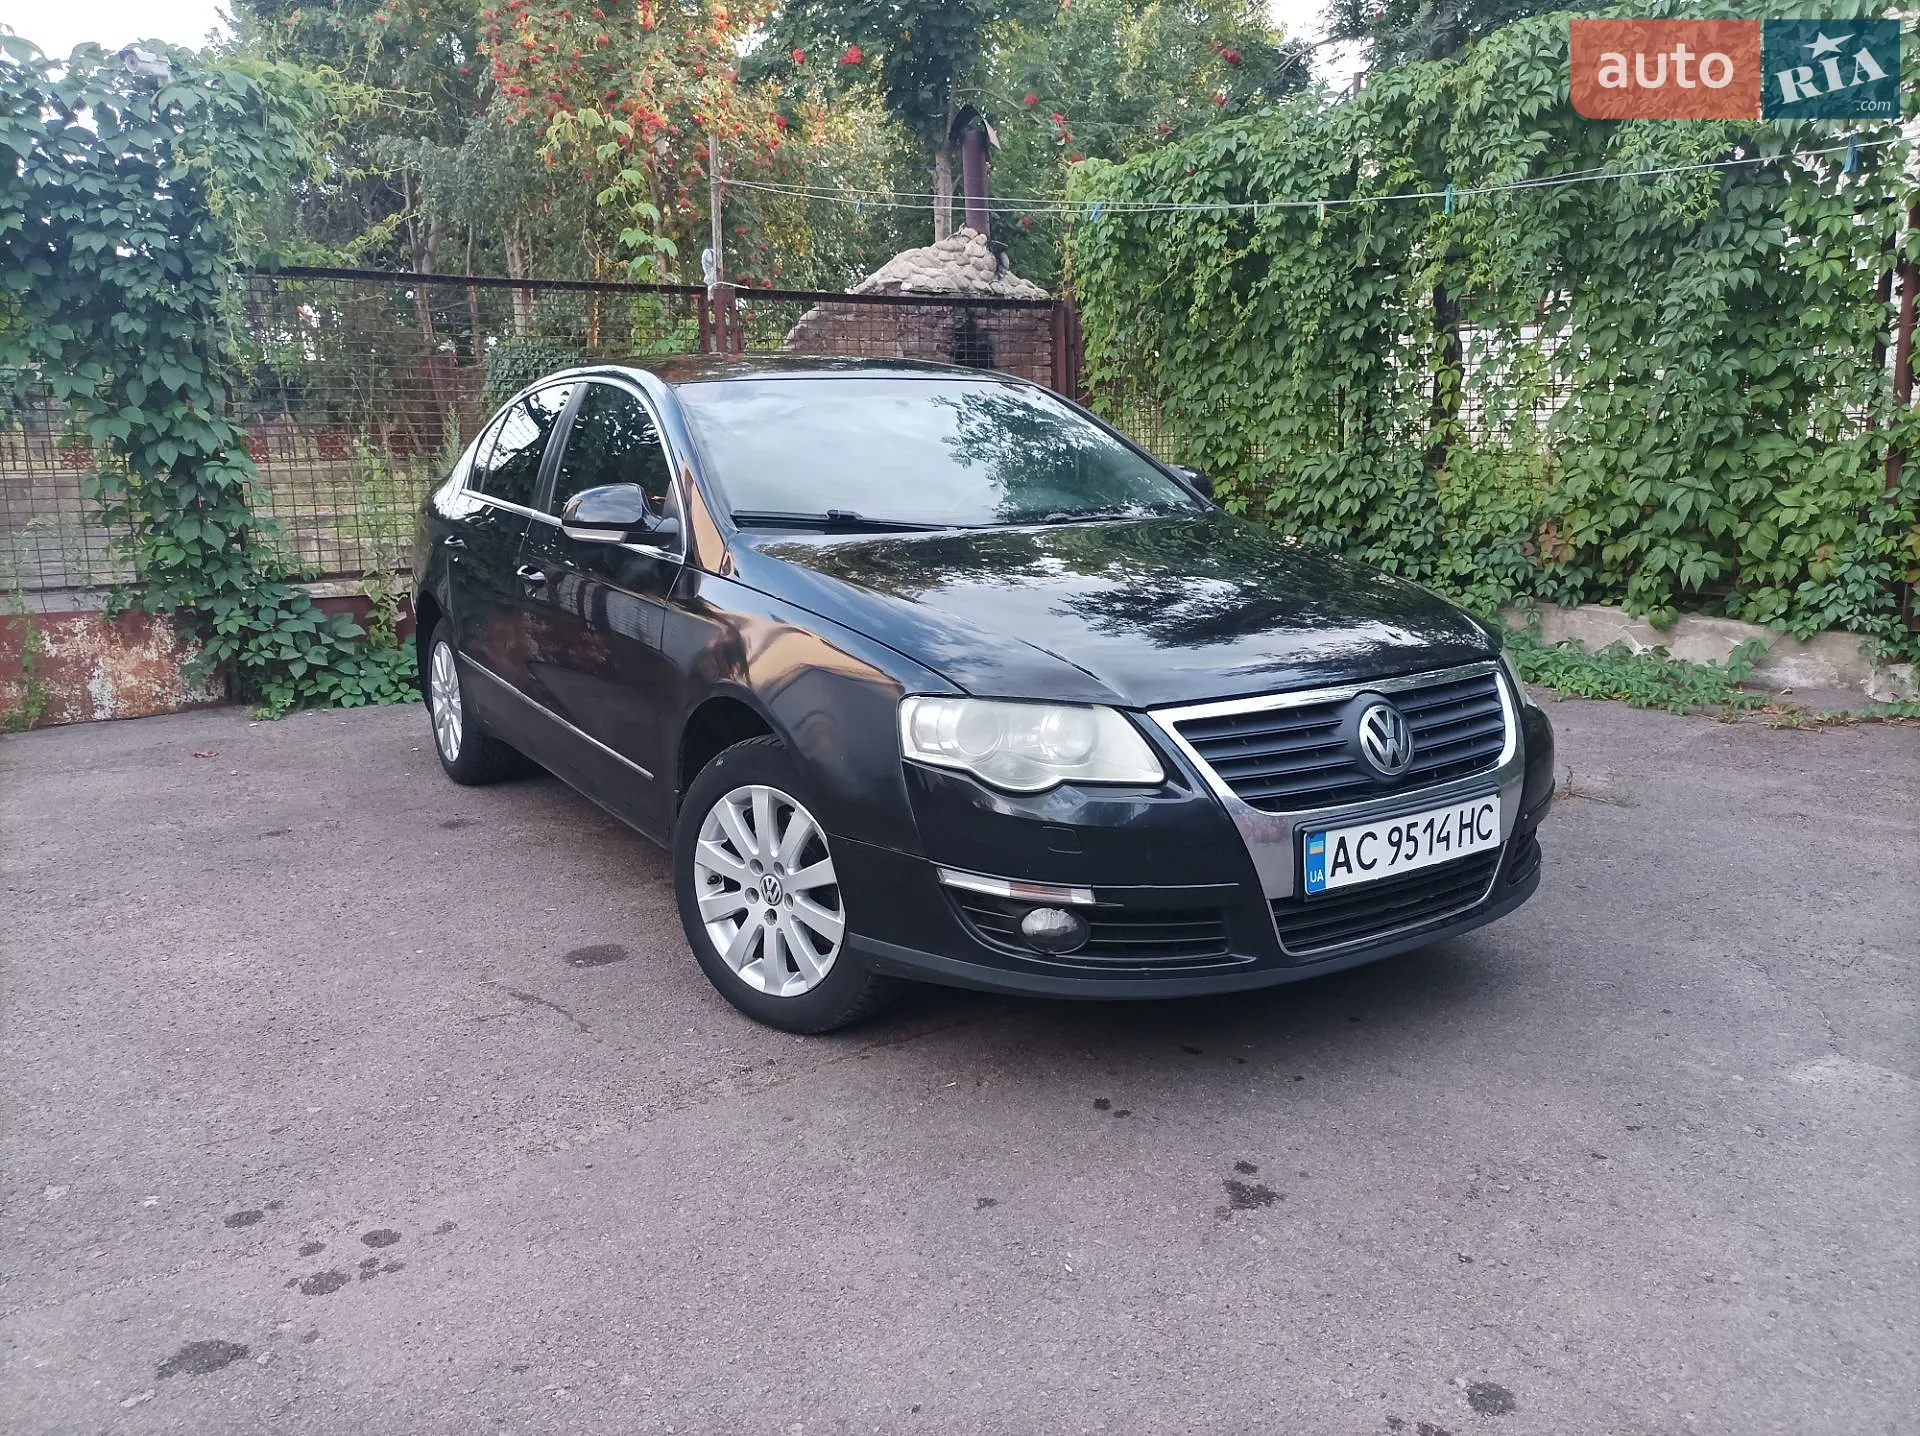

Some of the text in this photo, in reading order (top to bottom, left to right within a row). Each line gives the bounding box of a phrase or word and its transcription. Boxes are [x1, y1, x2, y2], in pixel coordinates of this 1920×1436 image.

[1330, 803, 1494, 878] AC 9514 HC
[1309, 870, 1324, 883] UA
